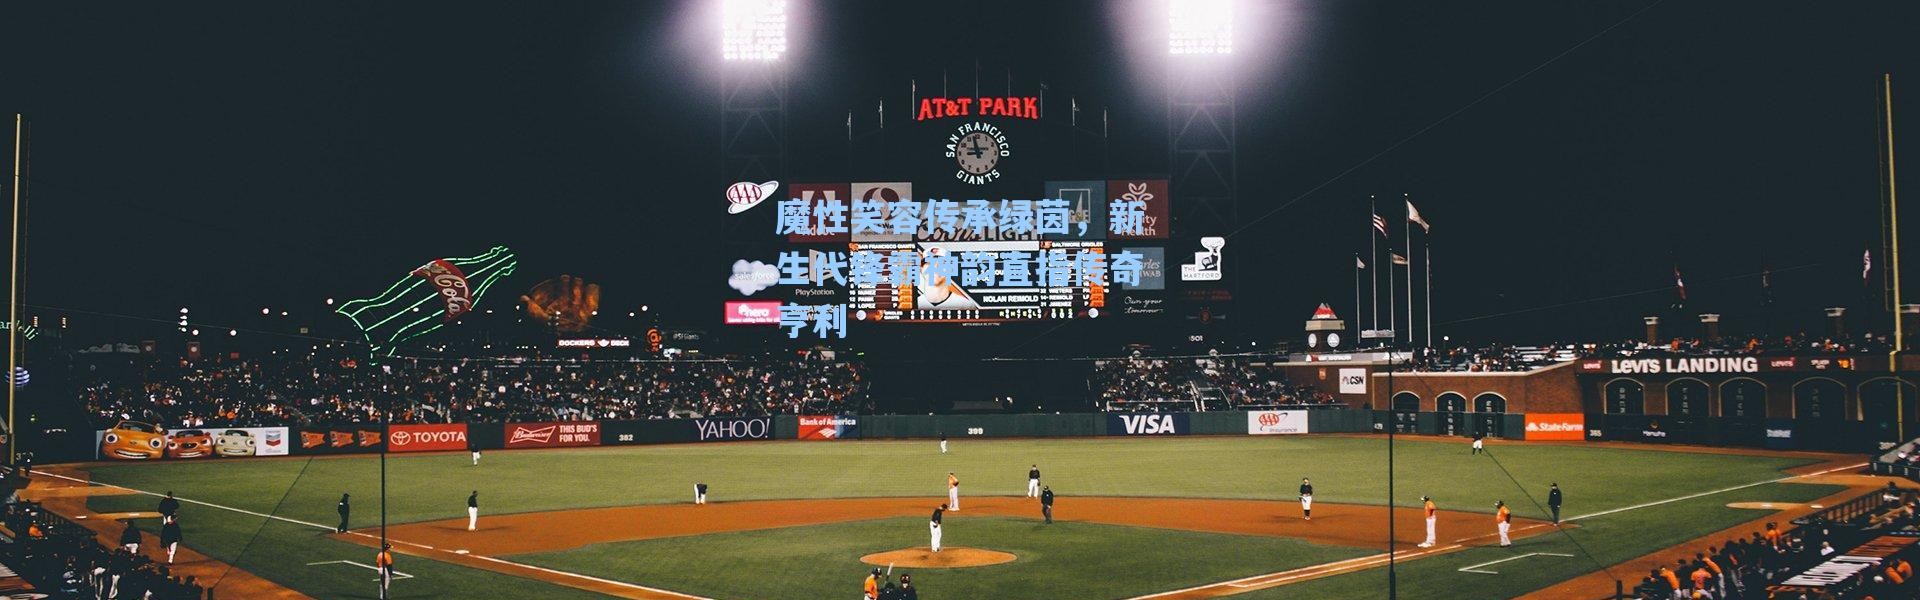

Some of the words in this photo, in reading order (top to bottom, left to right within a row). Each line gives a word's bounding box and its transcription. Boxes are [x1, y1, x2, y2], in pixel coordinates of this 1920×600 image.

[918, 98, 973, 121] AT&T
[979, 97, 1039, 119] PARK
[946, 134, 960, 158] SAN
[958, 121, 1010, 157] FRANCISCO
[956, 169, 1001, 185] GIANTS
[795, 288, 835, 297] PlayStation
[983, 295, 1007, 303] NOLAN
[558, 339, 596, 347] DOCKERS
[1666, 357, 1759, 373] LANDING
[1349, 376, 1364, 385] CSN
[800, 418, 818, 426] Bank
[818, 417, 828, 426] of
[828, 418, 857, 426] America
[1119, 414, 1176, 434] VISA
[559, 425, 576, 434] THIS
[576, 424, 598, 433] BUD'S
[695, 418, 771, 441] YAHOO!
[413, 431, 466, 443] TOYOTA
[513, 430, 552, 439] Budweiser
[559, 434, 574, 443] FOR
